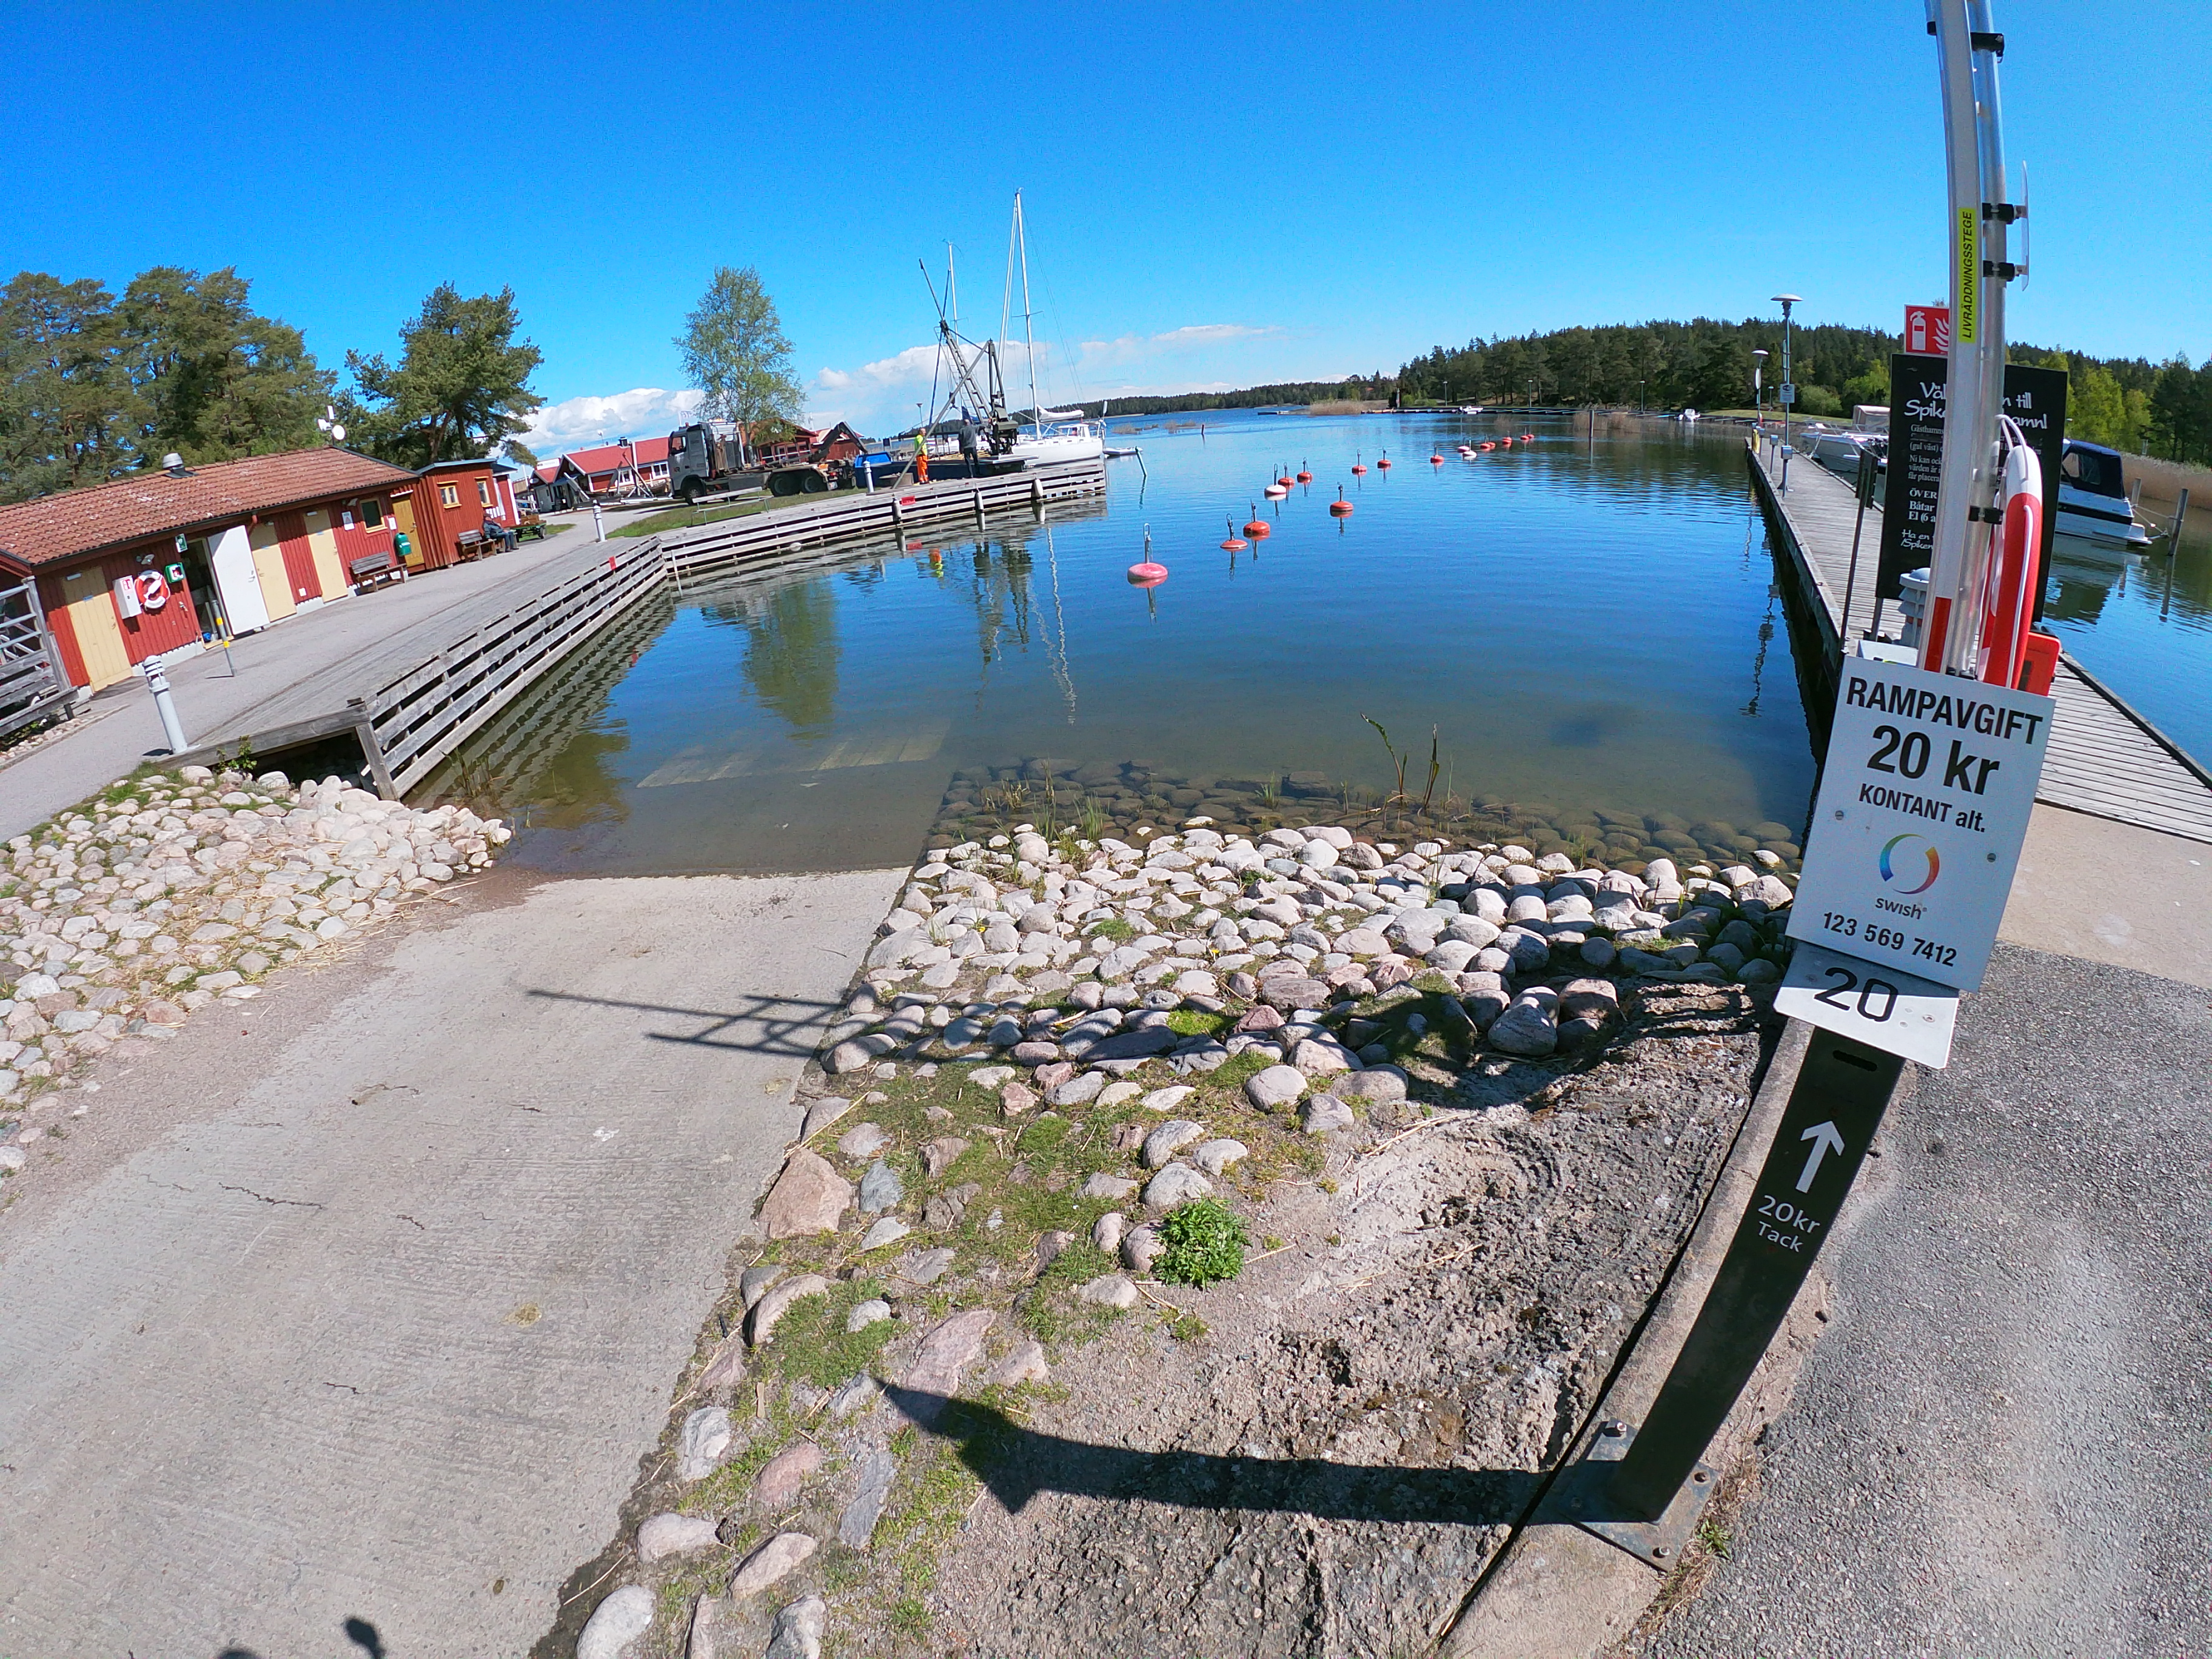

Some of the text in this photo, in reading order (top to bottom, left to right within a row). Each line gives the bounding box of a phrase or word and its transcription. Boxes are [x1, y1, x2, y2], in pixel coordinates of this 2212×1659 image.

[1960, 211, 1972, 339] LIVRÄDDNINGSSTEGE
[2015, 392, 2032, 409] till
[1919, 455, 1929, 464] kan
[1909, 487, 1937, 499] ÖVER
[1909, 500, 1936, 512] Båtar
[1908, 511, 1919, 520] El
[1902, 529, 1915, 538] Ha
[1846, 676, 2043, 745] RAMPAVGIFT
[1867, 725, 2000, 796] 20 kr
[1858, 783, 1985, 833] KONTANT alt.
[1823, 912, 1957, 967] 123 569 7412
[1814, 967, 1899, 1022] 20
[1758, 1195, 1820, 1234] 20kr
[1758, 1221, 1804, 1253] Tack
